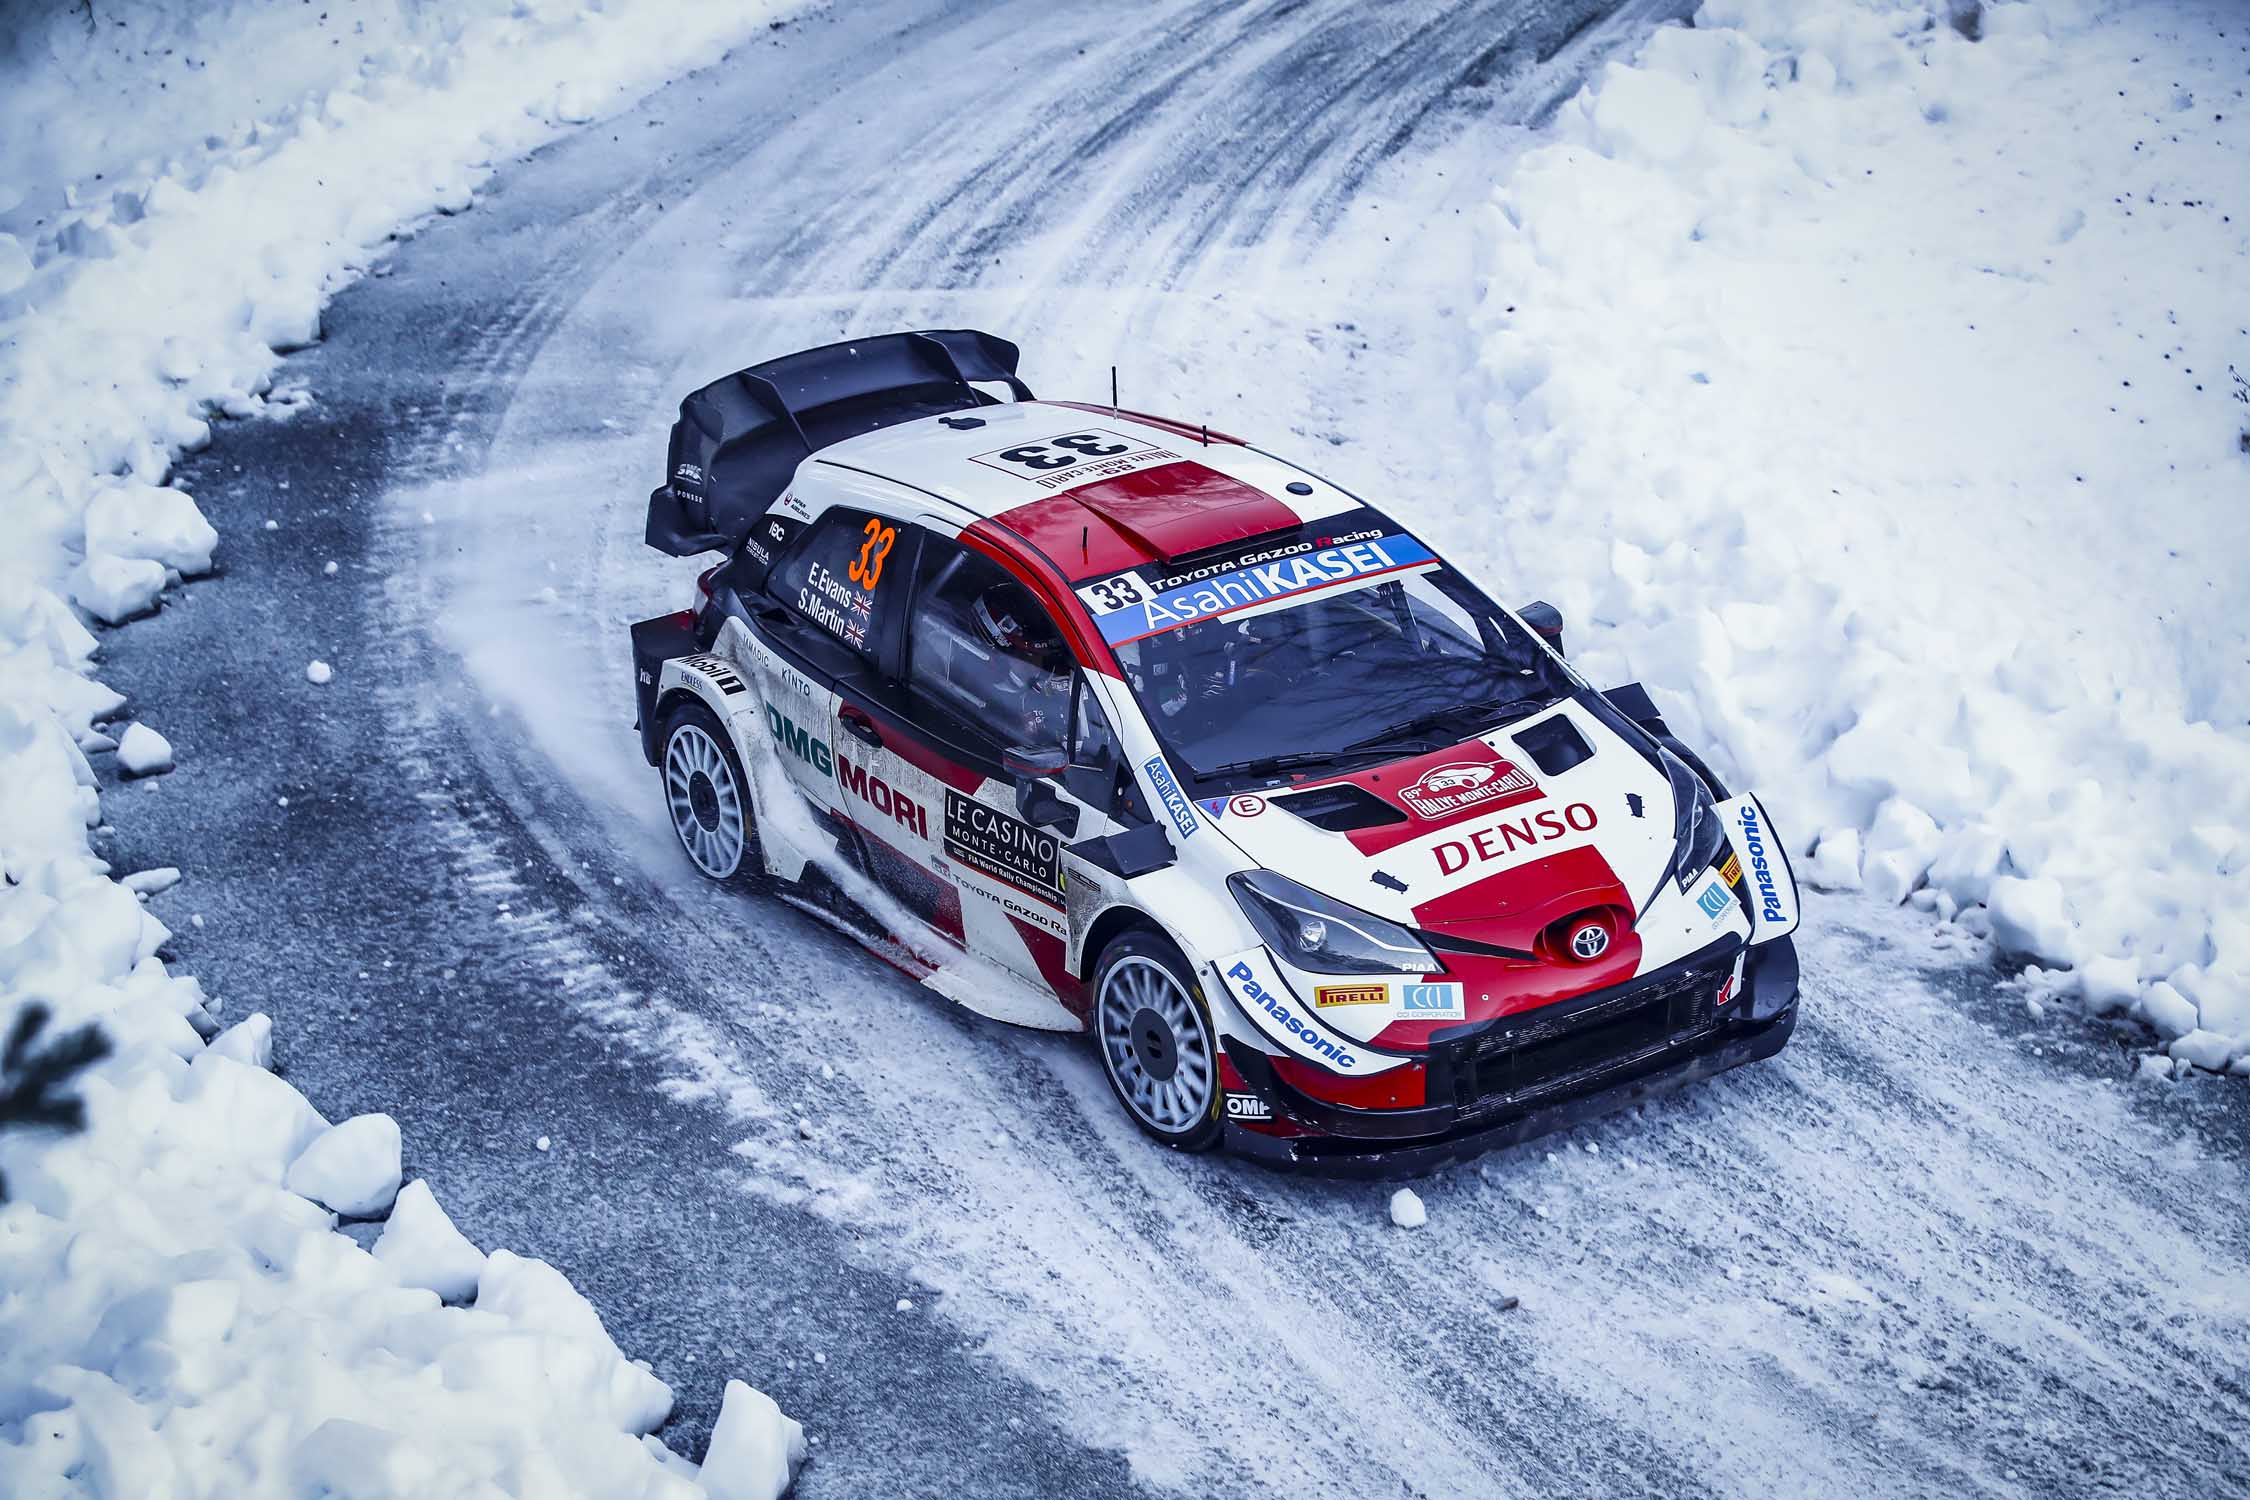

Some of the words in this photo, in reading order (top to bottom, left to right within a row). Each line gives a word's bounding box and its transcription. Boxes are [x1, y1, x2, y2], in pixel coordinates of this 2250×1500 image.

[999, 434, 1129, 470] 33
[791, 504, 811, 520] AIRLINES
[793, 497, 806, 508] JAPAN
[748, 537, 769, 561] NISULA
[849, 518, 896, 591] 33
[1150, 561, 1237, 590] TOYOTA
[1239, 542, 1313, 568] GAZOO
[1315, 528, 1384, 549] Racing
[808, 561, 852, 608] E.Evans
[1091, 576, 1146, 611] 33
[1141, 541, 1398, 630] AsahiKASEI
[798, 587, 845, 637] S.Martin
[677, 655, 731, 678] Mobil
[743, 633, 769, 668] TAMADIC
[766, 701, 834, 778] DMG
[838, 753, 930, 842] MORI
[1147, 762, 1196, 834] AsahiKASEI
[1239, 799, 1257, 813] E
[1413, 795, 1460, 815] RALLYE
[1456, 769, 1531, 803] MONTE-CARLO
[947, 796, 967, 824] LE
[971, 808, 1054, 863] CASINO
[1431, 802, 1599, 877] DENSO
[968, 854, 979, 865] FIA
[979, 859, 998, 874] World
[998, 868, 1015, 883] Rally
[1015, 876, 1058, 903] Championship
[1681, 868, 1699, 888] PIAA
[1738, 805, 1788, 923] Panasonic
[953, 873, 1001, 904] TOYOTA
[1003, 899, 1048, 926] GAZOO
[1401, 962, 1436, 972] PIAA
[1227, 961, 1356, 1069] Panasonic
[1320, 985, 1384, 1004] PIRELLI
